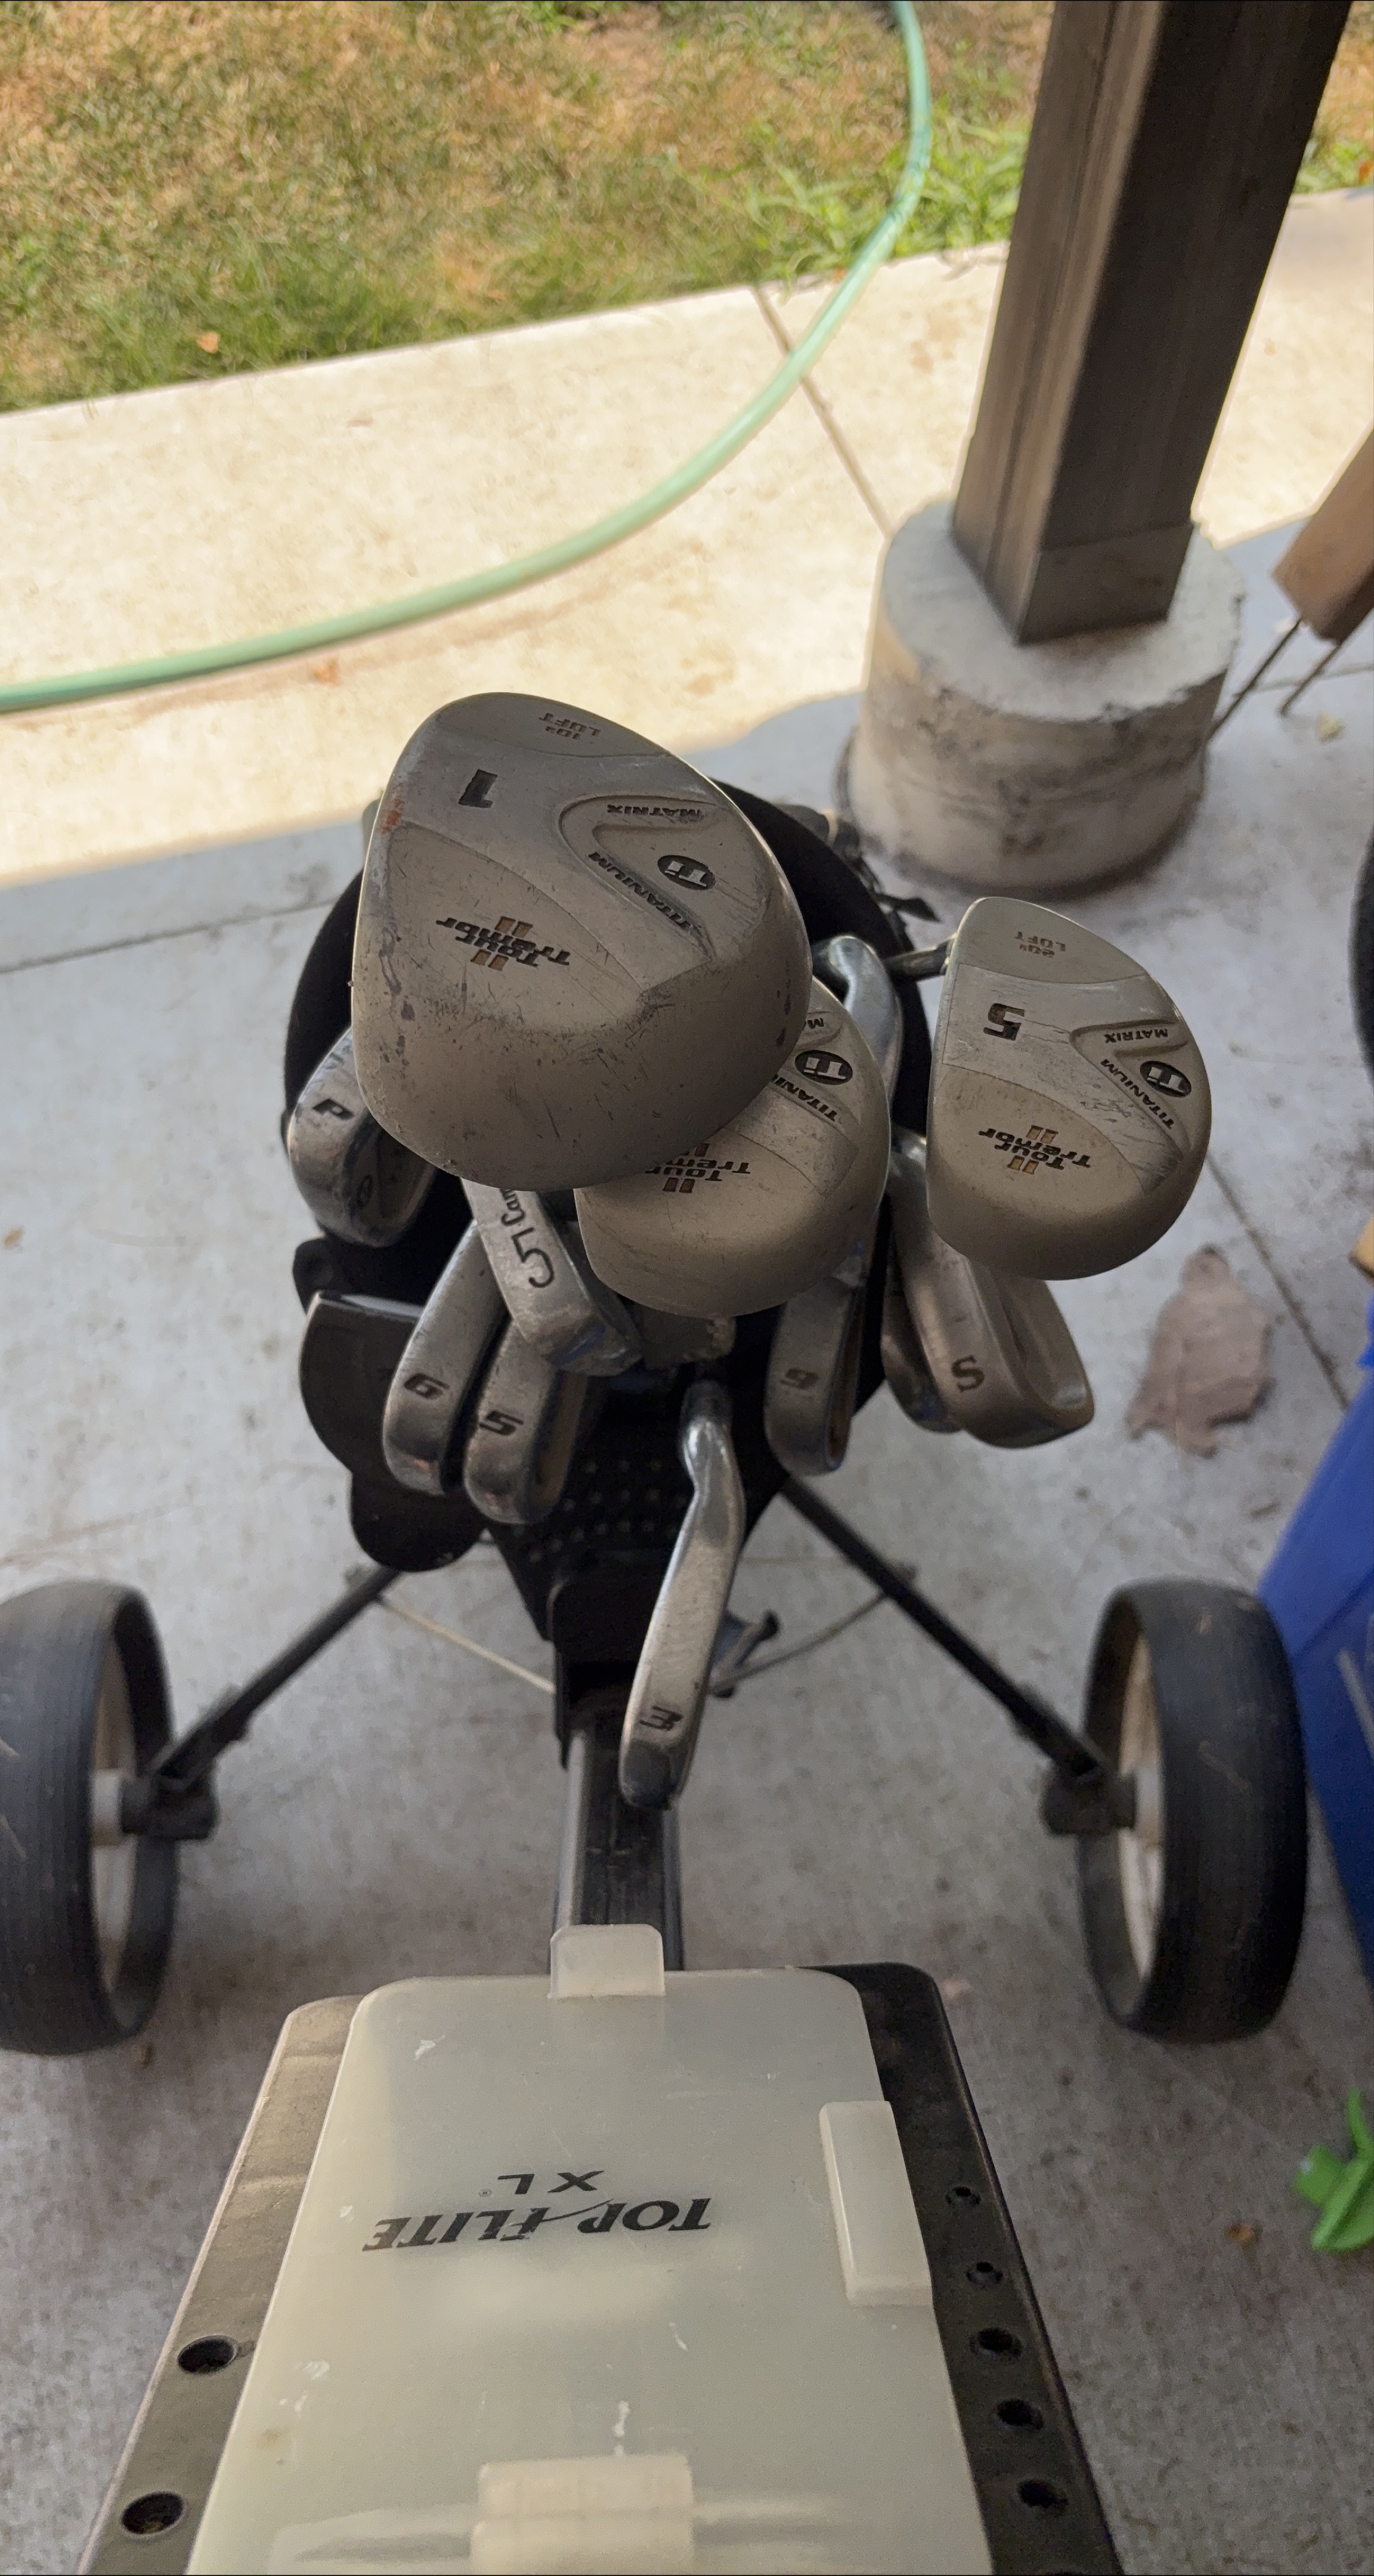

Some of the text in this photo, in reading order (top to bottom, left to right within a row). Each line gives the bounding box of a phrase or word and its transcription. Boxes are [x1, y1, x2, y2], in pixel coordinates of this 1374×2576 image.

[539, 713, 601, 736] LOFT
[458, 769, 498, 809] 1
[607, 804, 705, 823] MATRIX
[663, 859, 708, 889] Ti
[588, 852, 692, 931] TITANIUM
[455, 934, 538, 967] Tour
[1014, 931, 1066, 952] LOFT
[983, 1003, 1025, 1041] 5
[1104, 1029, 1169, 1044] MATRIX
[802, 1055, 848, 1082] Ti
[1145, 1066, 1188, 1095] Ti
[772, 1075, 838, 1121] TITANI
[1100, 1059, 1175, 1129] TITANIUM
[666, 1158, 750, 1174] Trem
[994, 1143, 1064, 1170] Tour
[645, 1166, 722, 1181] Tour
[952, 1355, 985, 1393] S
[479, 1410, 524, 1436] 5
[639, 1705, 684, 1731] 3
[497, 2170, 605, 2195] XL
[578, 2199, 711, 2234] TOP
